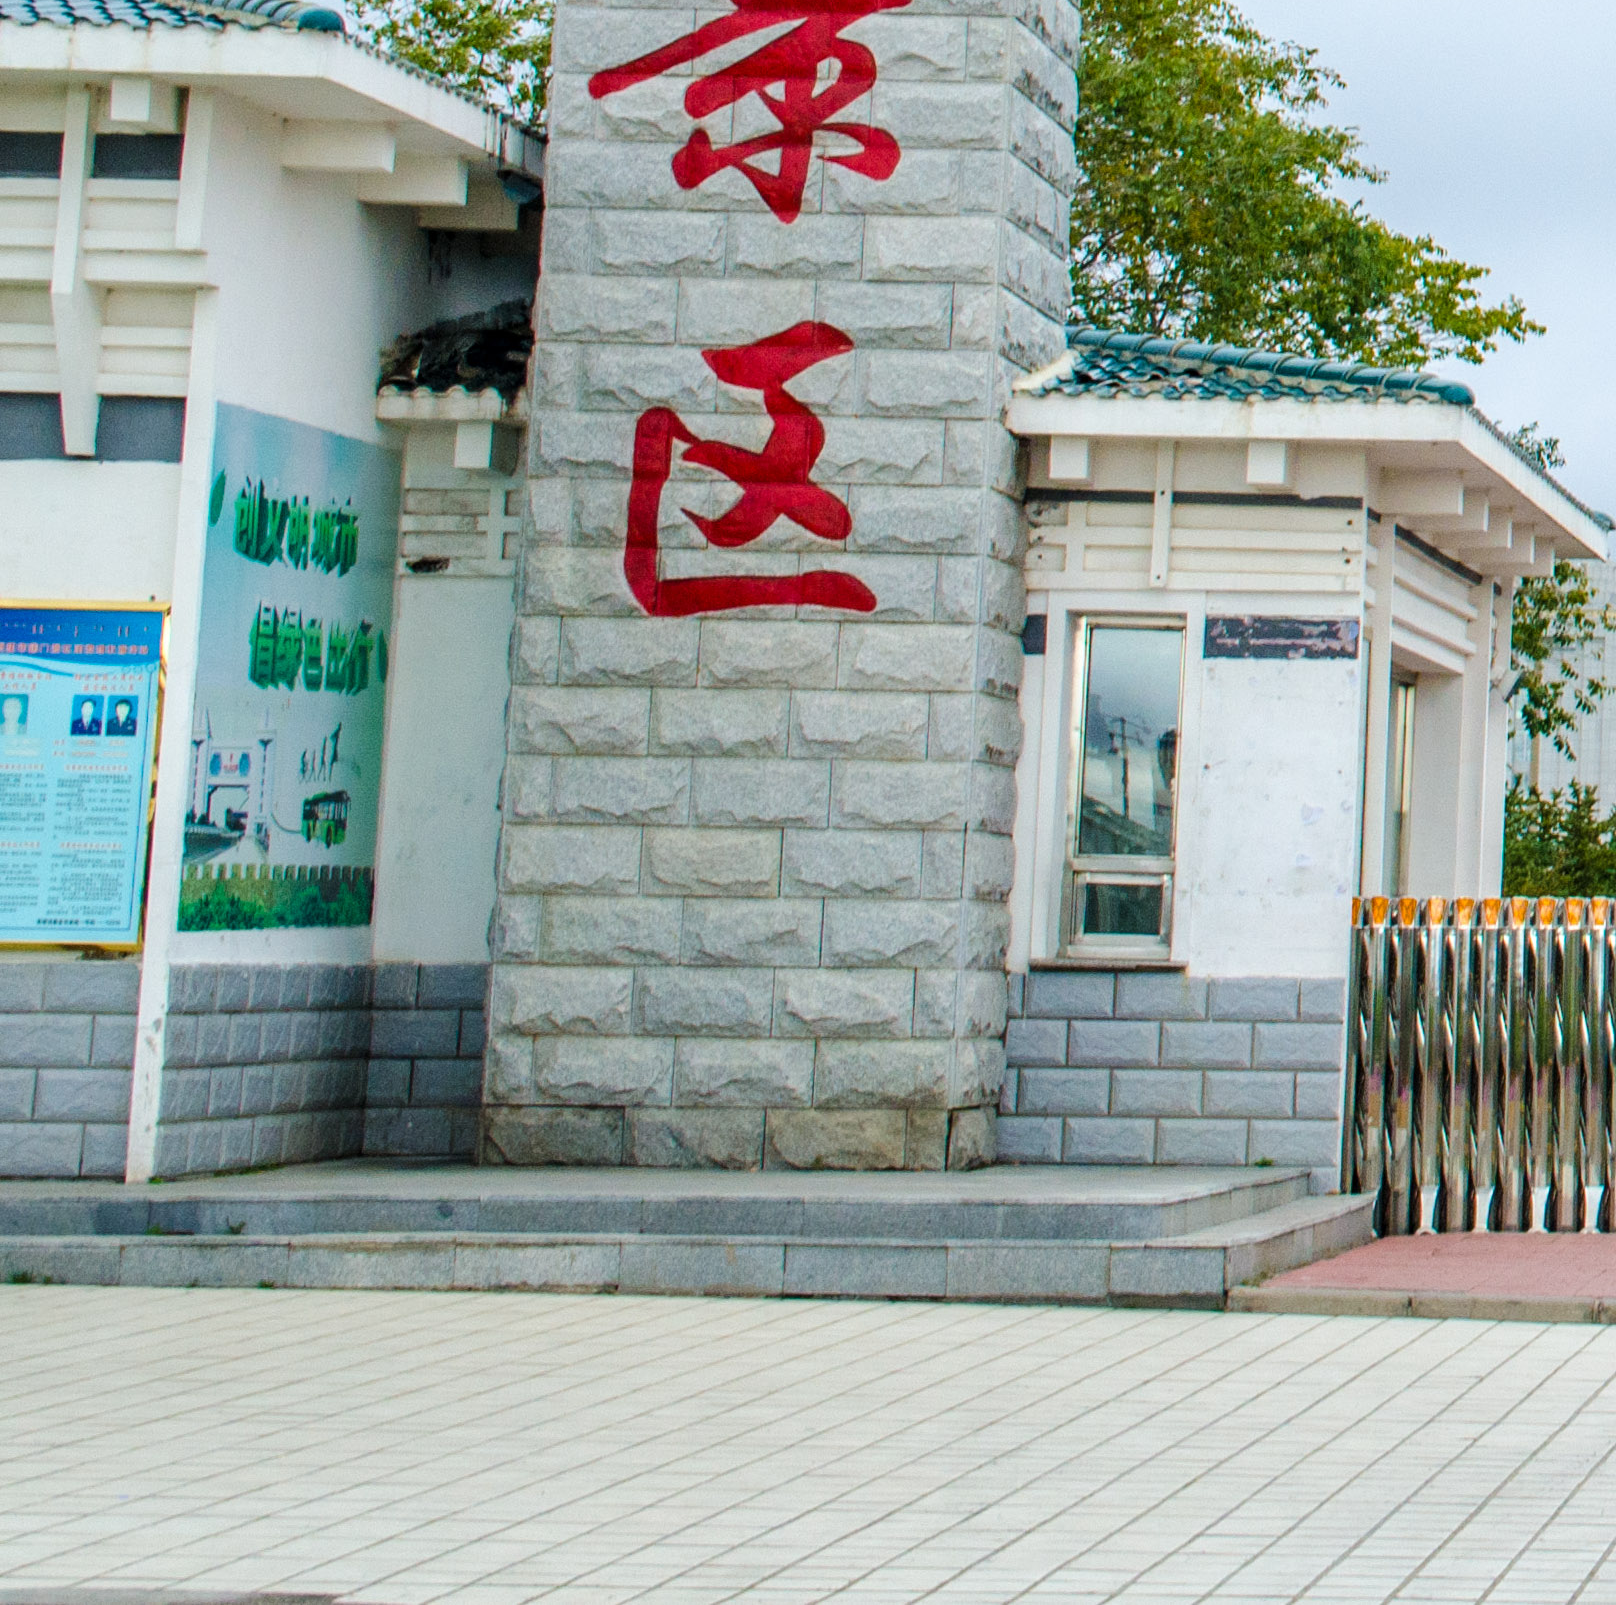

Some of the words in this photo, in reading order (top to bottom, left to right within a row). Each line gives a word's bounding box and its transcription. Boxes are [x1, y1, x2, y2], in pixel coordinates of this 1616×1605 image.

[234, 476, 358, 578] 创文明城市
[249, 600, 374, 696] 倡绿色出行
